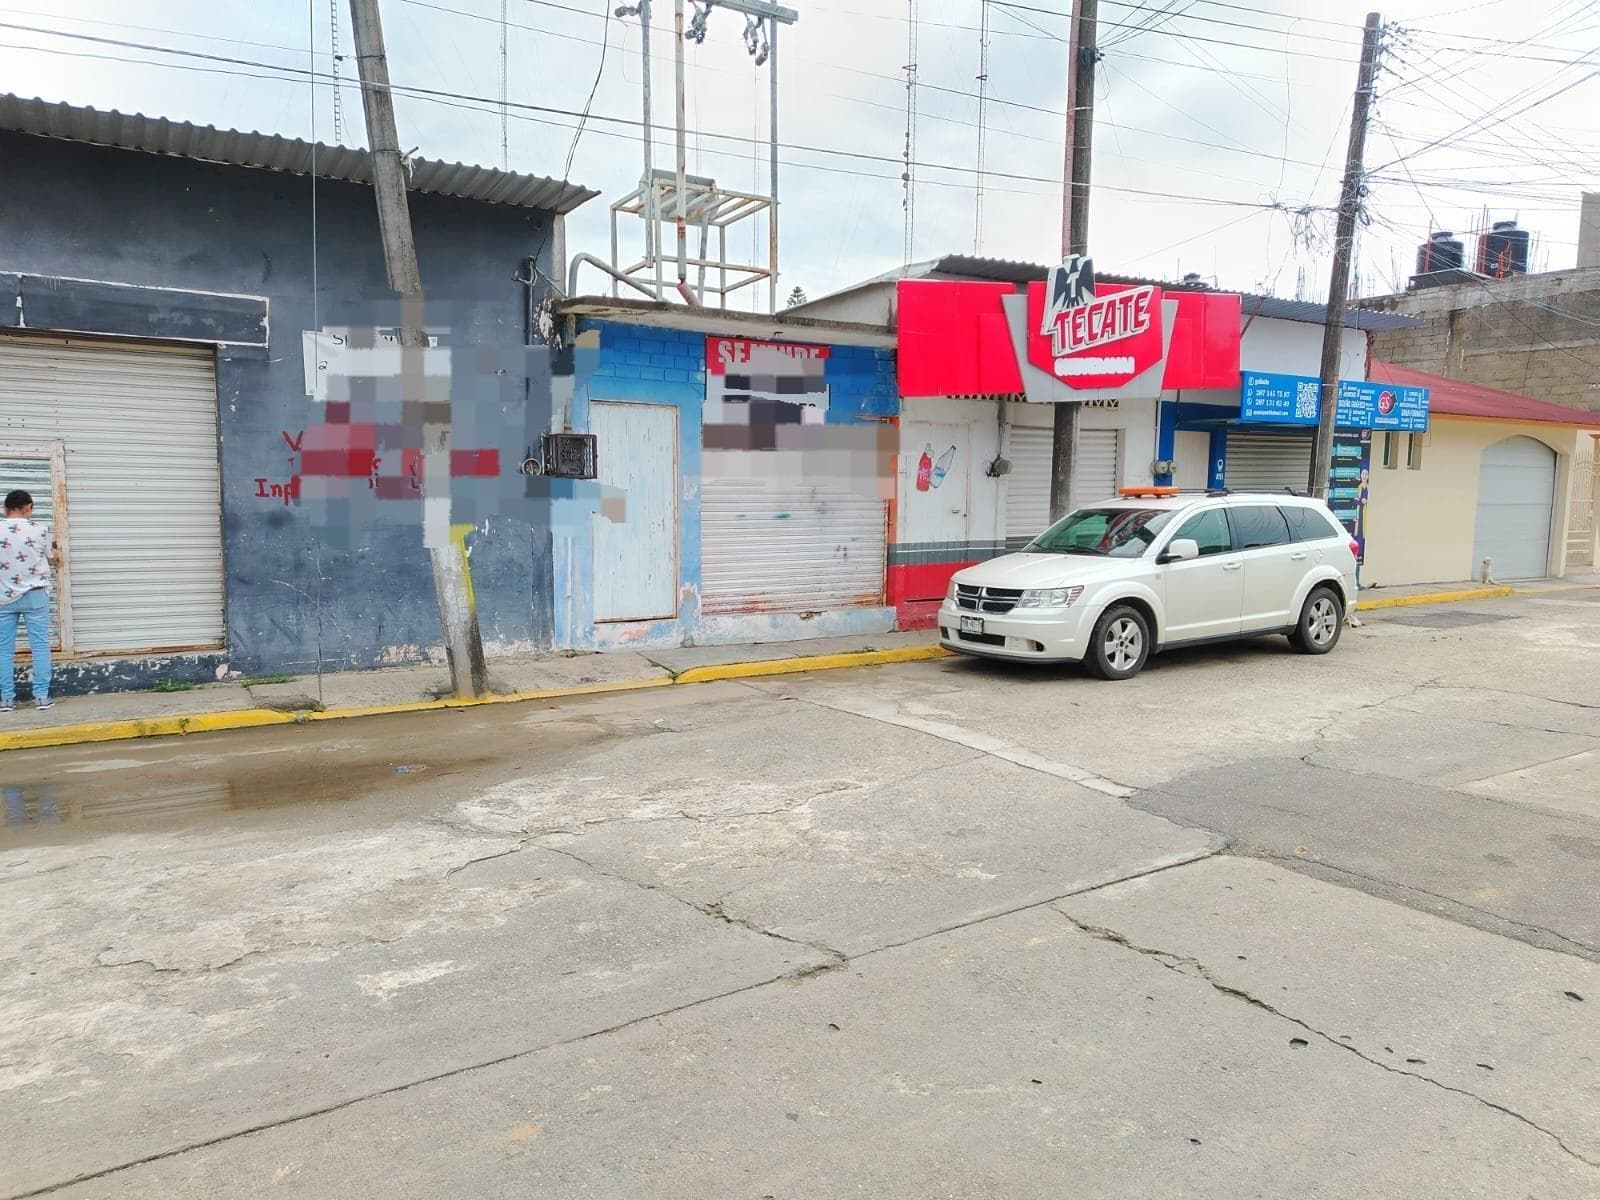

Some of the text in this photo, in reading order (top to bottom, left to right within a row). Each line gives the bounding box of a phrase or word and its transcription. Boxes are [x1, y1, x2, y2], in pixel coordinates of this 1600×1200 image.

[1052, 288, 1152, 352] TECATE
[718, 340, 750, 363] SE
[1380, 396, 1391, 411] GS
